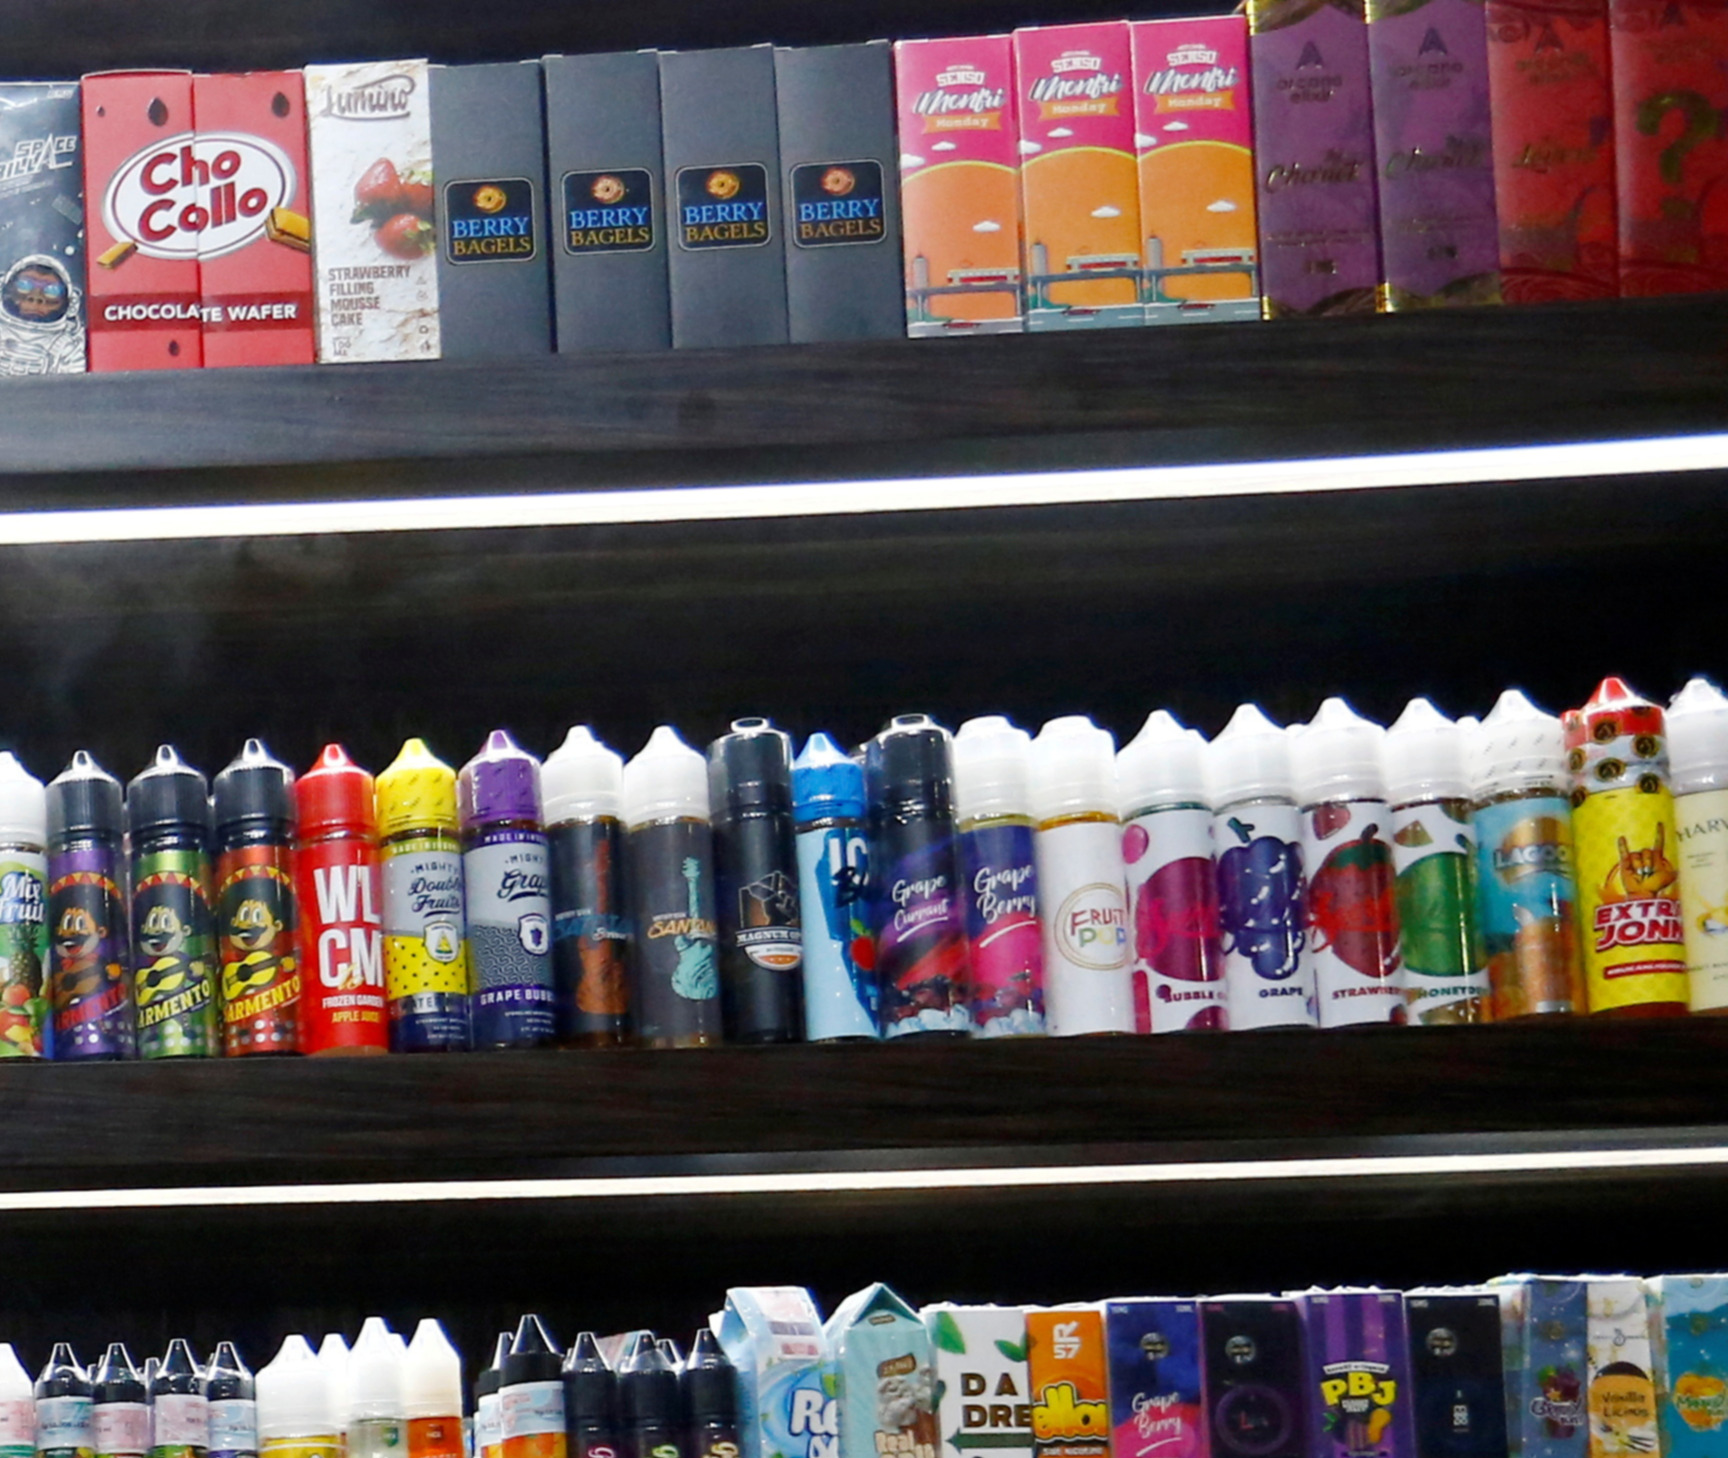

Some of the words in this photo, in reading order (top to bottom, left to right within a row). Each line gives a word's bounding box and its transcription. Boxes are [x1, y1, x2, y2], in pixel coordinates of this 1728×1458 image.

[1053, 101, 1106, 115] Monday
[1168, 95, 1221, 109] Monday
[936, 115, 988, 128] Monday
[140, 145, 242, 195] Cho
[138, 183, 268, 243] Collo
[570, 206, 648, 230] BERRY
[684, 201, 763, 224] BERRY
[799, 198, 879, 221] BERRY
[453, 217, 529, 238] BERRY
[570, 227, 649, 247] BAGELS
[685, 221, 765, 242] BAGELS
[799, 219, 881, 240] BAGELS
[453, 236, 531, 256] BAGELS
[328, 266, 410, 281] STRAWBERRY
[329, 282, 374, 296] FILLING
[104, 302, 223, 323] CHOCOLATE
[228, 302, 297, 322] WAFER
[331, 296, 380, 312] MOUSSE
[331, 312, 363, 327] CAKE
[1, 870, 42, 900] Mix
[892, 875, 945, 906] Grape
[974, 864, 1033, 898] Grape
[313, 864, 381, 926] WL
[894, 900, 949, 931] Currant
[977, 894, 1036, 927] Berry
[1070, 909, 1124, 937] FRUIT
[317, 927, 384, 988] CM
[137, 979, 211, 1028] ARMENTO
[480, 988, 521, 1006] GRAPE
[1259, 985, 1303, 999] GRAPE
[54, 982, 127, 1031] ARMENTO
[1321, 1371, 1397, 1407] PBJ
[1132, 1391, 1181, 1414] Grape
[963, 1403, 1032, 1429] DRE
[1137, 1411, 1183, 1440] Berry
